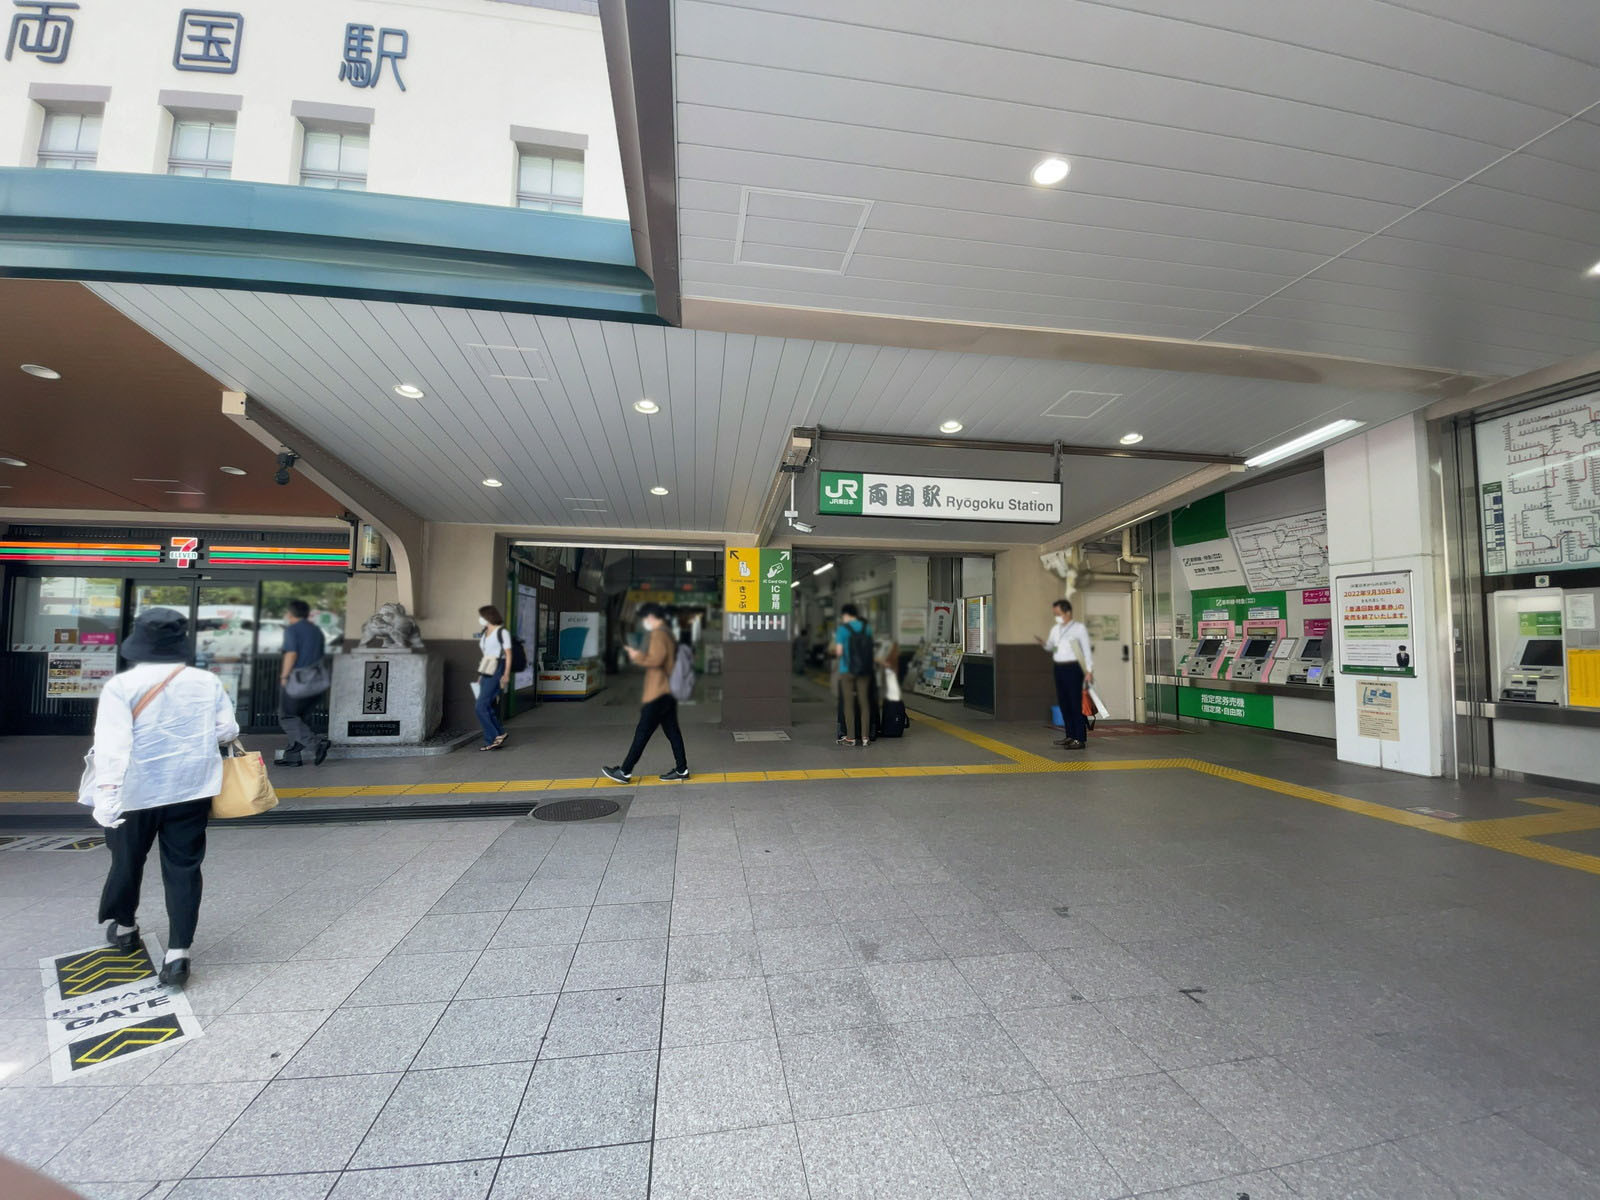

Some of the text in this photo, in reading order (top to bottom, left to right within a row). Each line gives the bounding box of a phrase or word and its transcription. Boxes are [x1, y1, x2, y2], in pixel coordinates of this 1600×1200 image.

[4, 0, 406, 92] 両国駅
[825, 479, 859, 499] JR
[868, 483, 1053, 512] 両国駅 Ryōgoku Station
[171, 537, 198, 568] 7
[366, 664, 384, 711] 力相撲
[65, 994, 171, 1031] GATE
